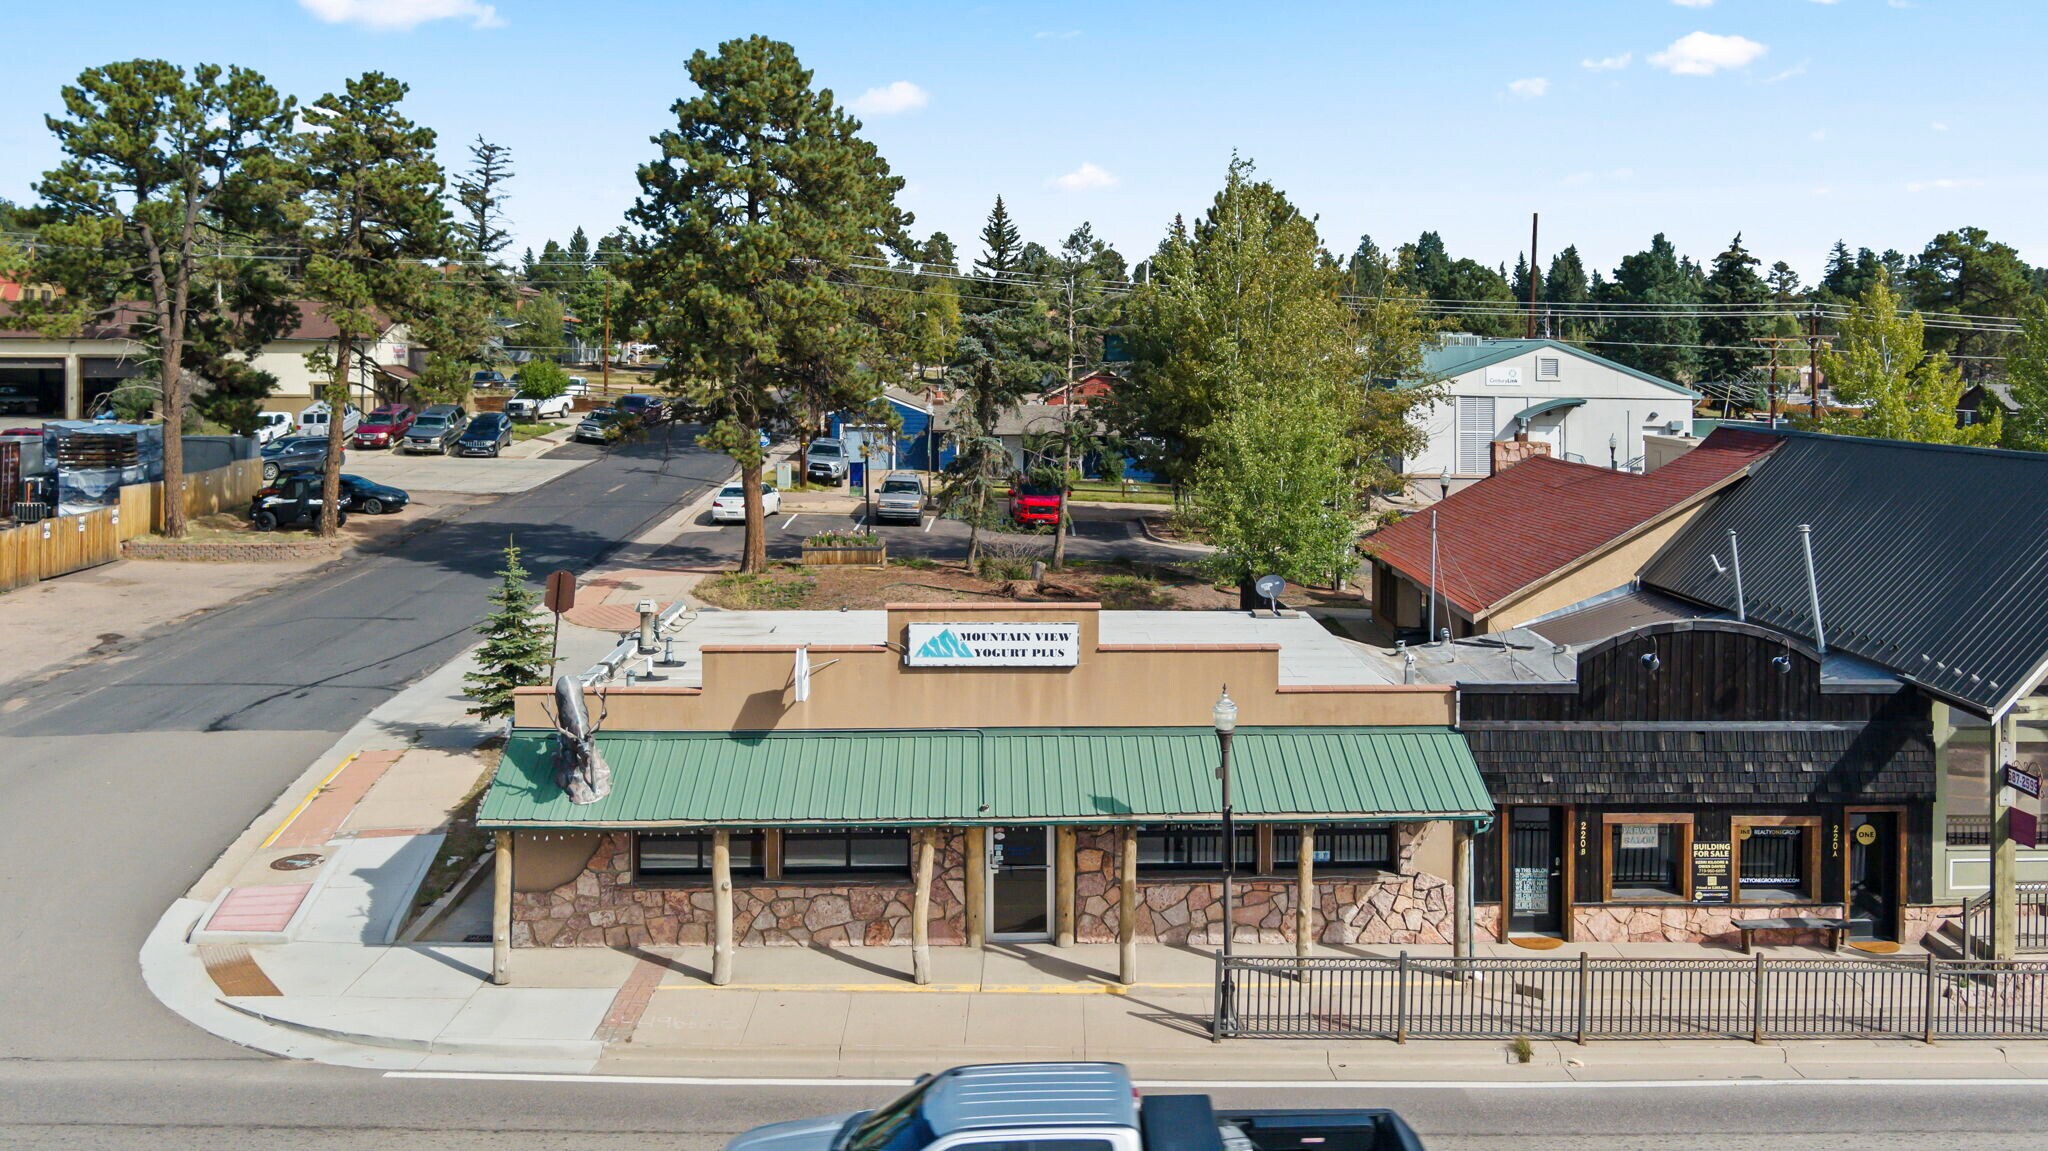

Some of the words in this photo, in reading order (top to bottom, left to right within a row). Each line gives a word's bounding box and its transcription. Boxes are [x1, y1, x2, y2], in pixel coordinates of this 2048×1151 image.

[960, 632, 1031, 642] MOUNTAIN
[1036, 632, 1072, 642] VIEW
[974, 648, 1028, 658] YOGURT
[1032, 648, 1065, 658] PLUS
[1693, 843, 1731, 851] BUILDING
[1693, 850, 1709, 858] FOR
[1710, 850, 1730, 858] SALE
